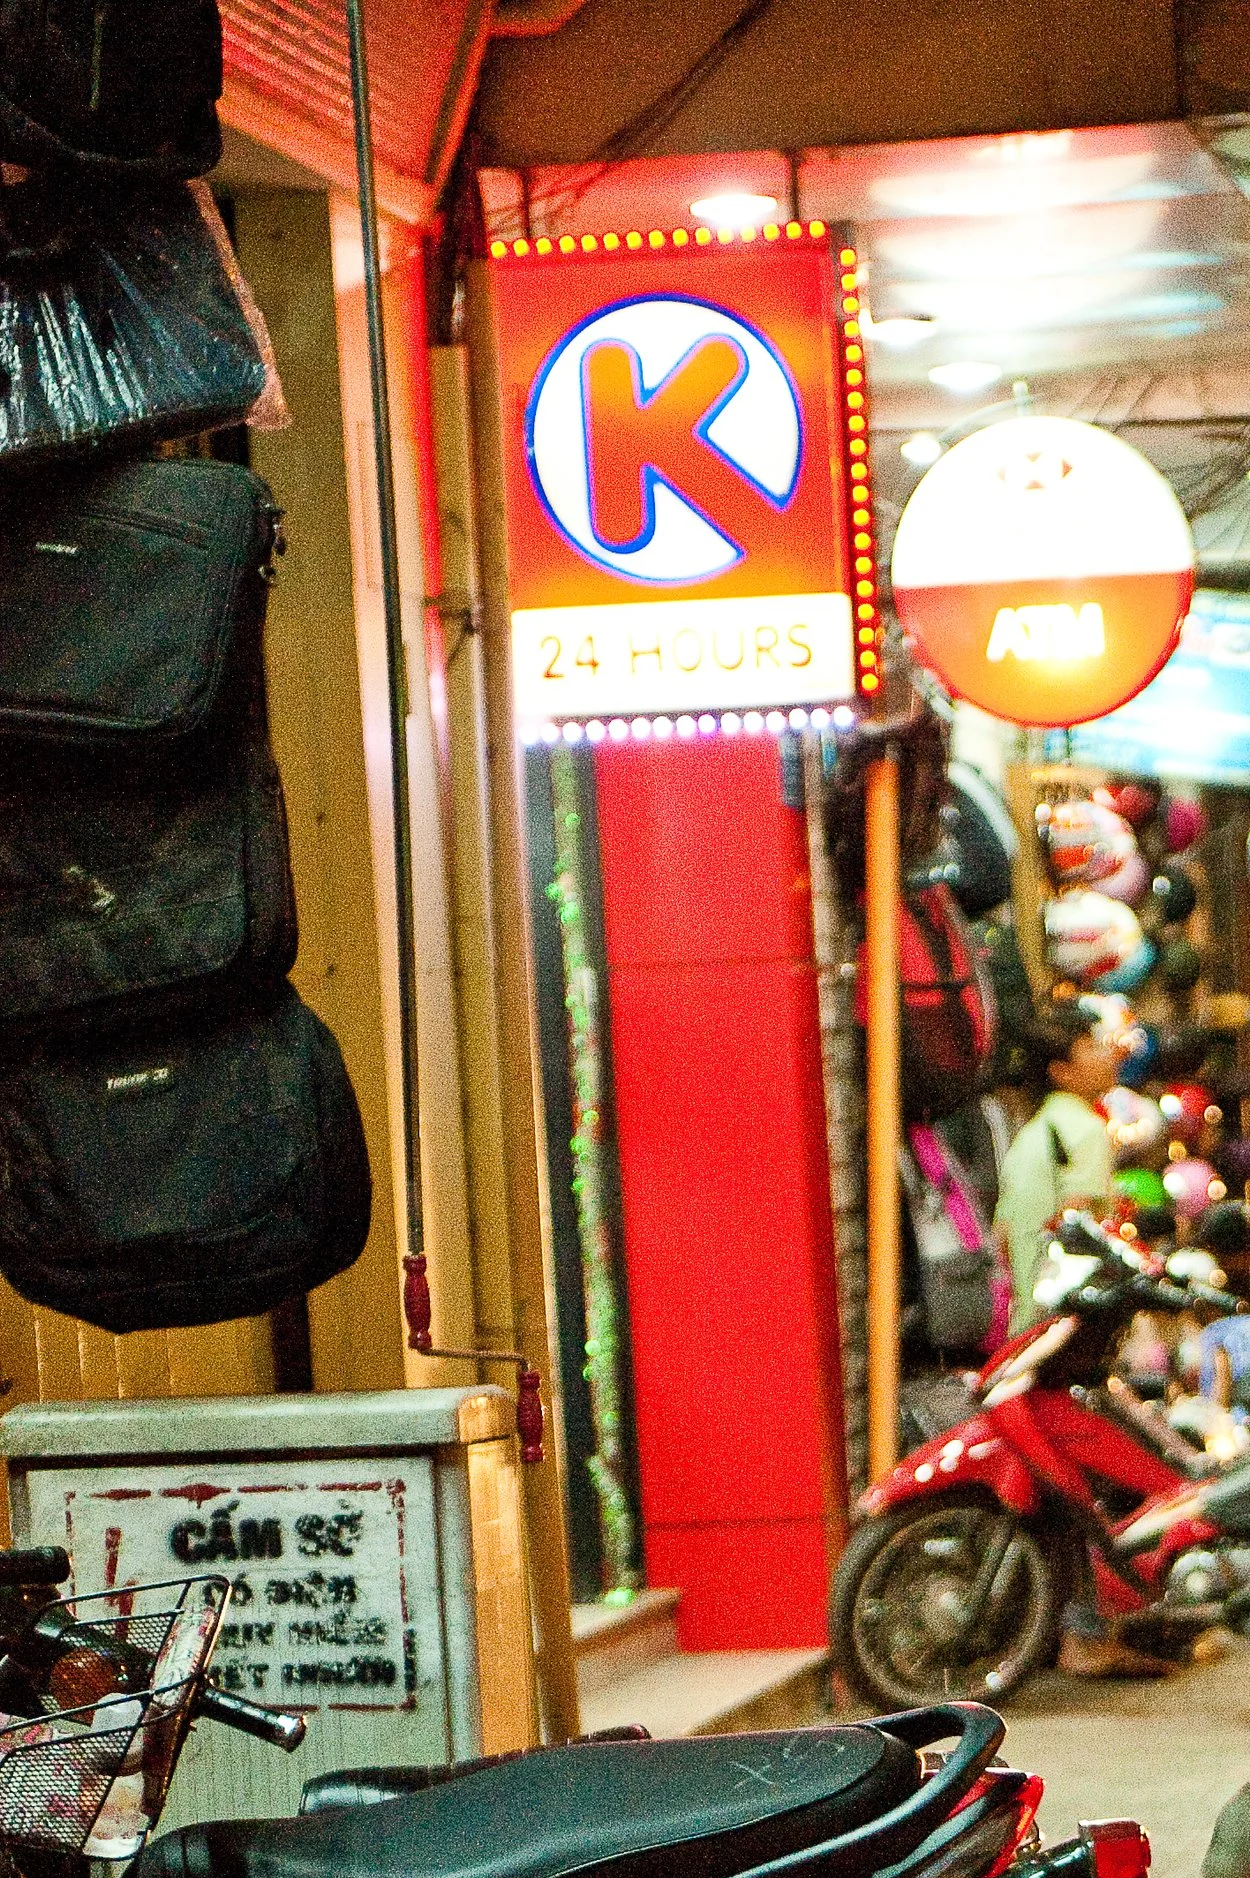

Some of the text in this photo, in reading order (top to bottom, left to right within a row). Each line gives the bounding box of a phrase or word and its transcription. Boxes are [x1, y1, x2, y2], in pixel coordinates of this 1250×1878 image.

[578, 330, 788, 560] K
[540, 623, 813, 679] 24 HOURS
[985, 602, 1105, 663] ATM
[170, 1499, 283, 1563] CẤM
